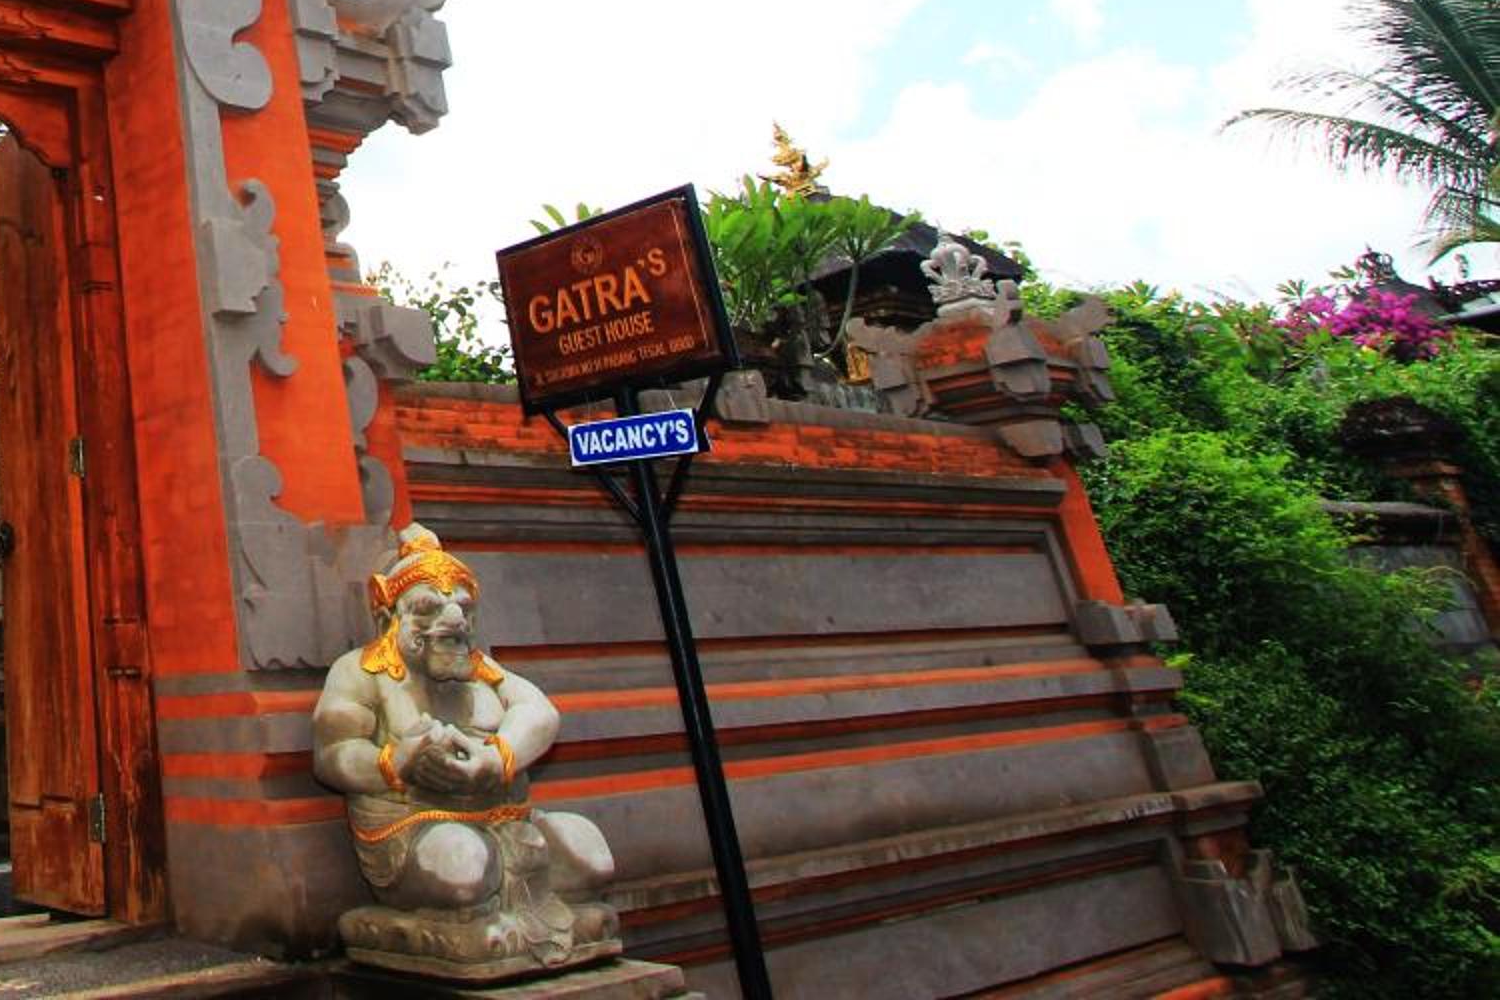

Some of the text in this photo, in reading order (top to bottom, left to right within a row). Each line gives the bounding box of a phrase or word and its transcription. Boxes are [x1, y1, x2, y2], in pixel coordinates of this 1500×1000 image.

[528, 247, 667, 333] GATRA'S
[559, 311, 655, 355] GUEST HOUSE
[576, 418, 689, 456] VACANCY'S
